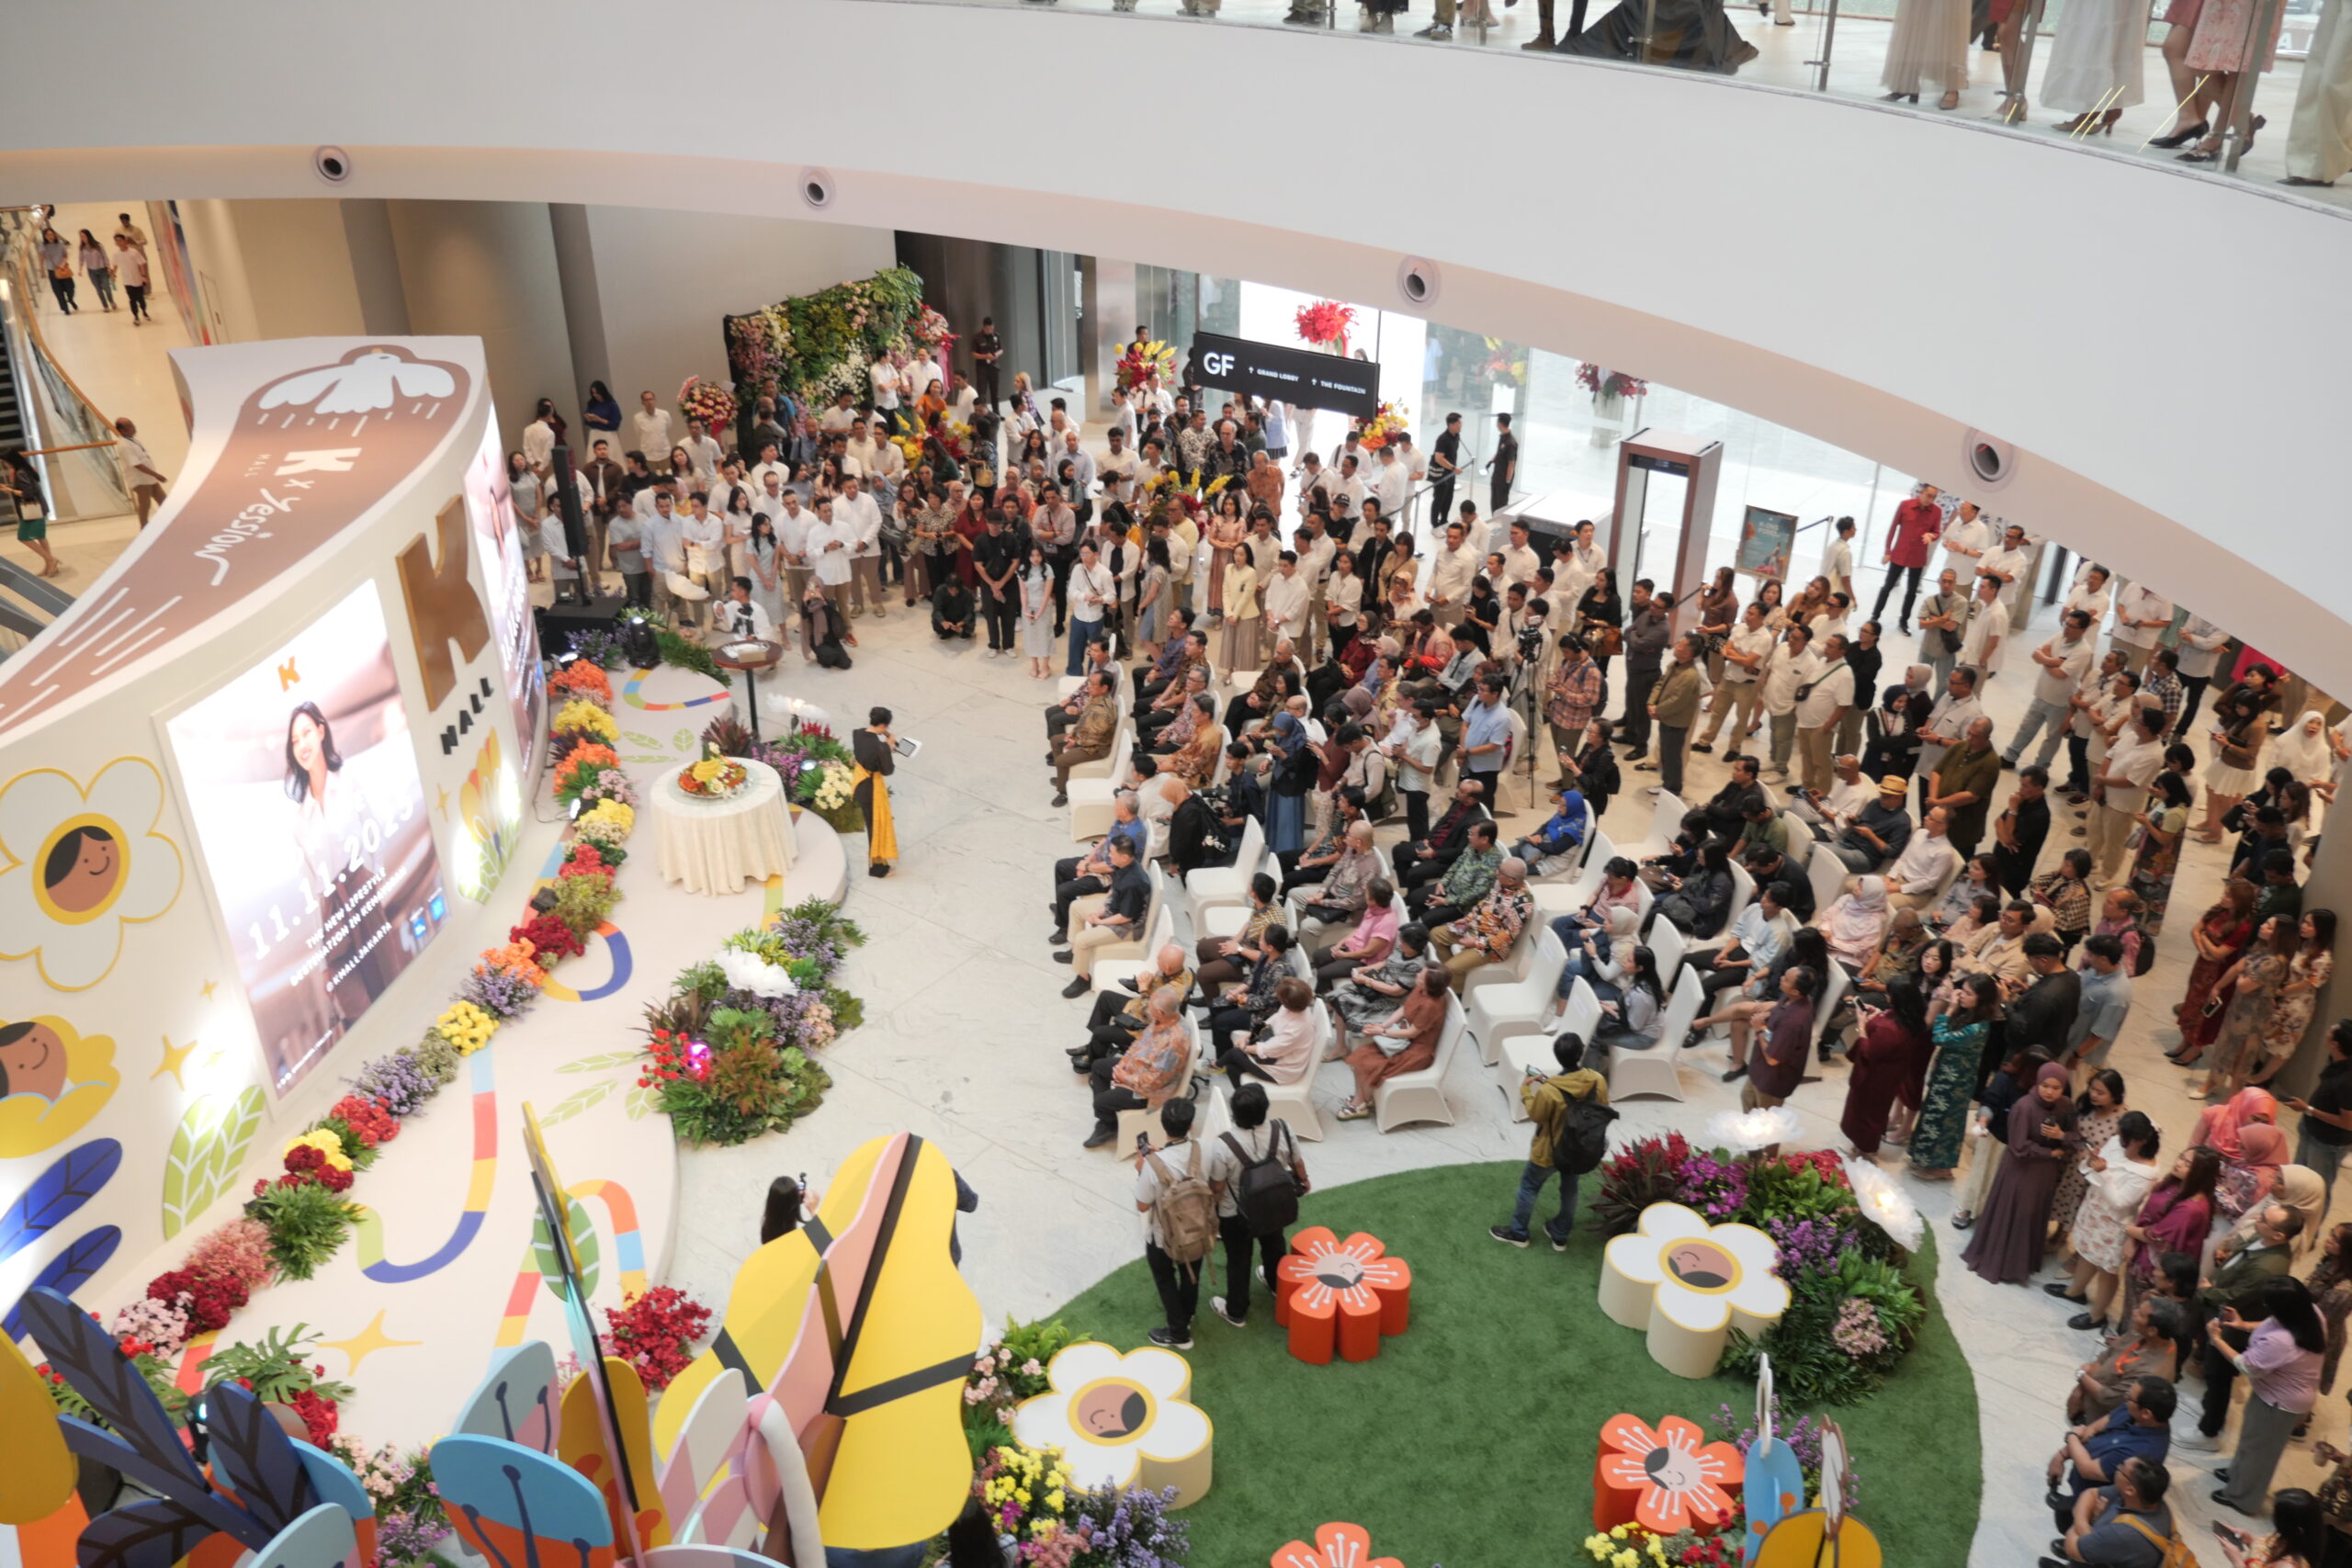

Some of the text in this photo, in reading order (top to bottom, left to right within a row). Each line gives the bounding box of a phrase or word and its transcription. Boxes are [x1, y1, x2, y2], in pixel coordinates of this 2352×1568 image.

[1203, 351, 1236, 377] GF
[1256, 368, 1299, 382] GRAND LOBBY
[1320, 379, 1366, 395] THE FOUNTAIN
[273, 446, 363, 476] K
[396, 493, 491, 712] K
[277, 656, 301, 693] K
[440, 676, 494, 755] MALL
[306, 867, 387, 949] THE NEW LIFESTYLE
[289, 925, 350, 987] DESTINATION
[349, 913, 362, 930] IN
